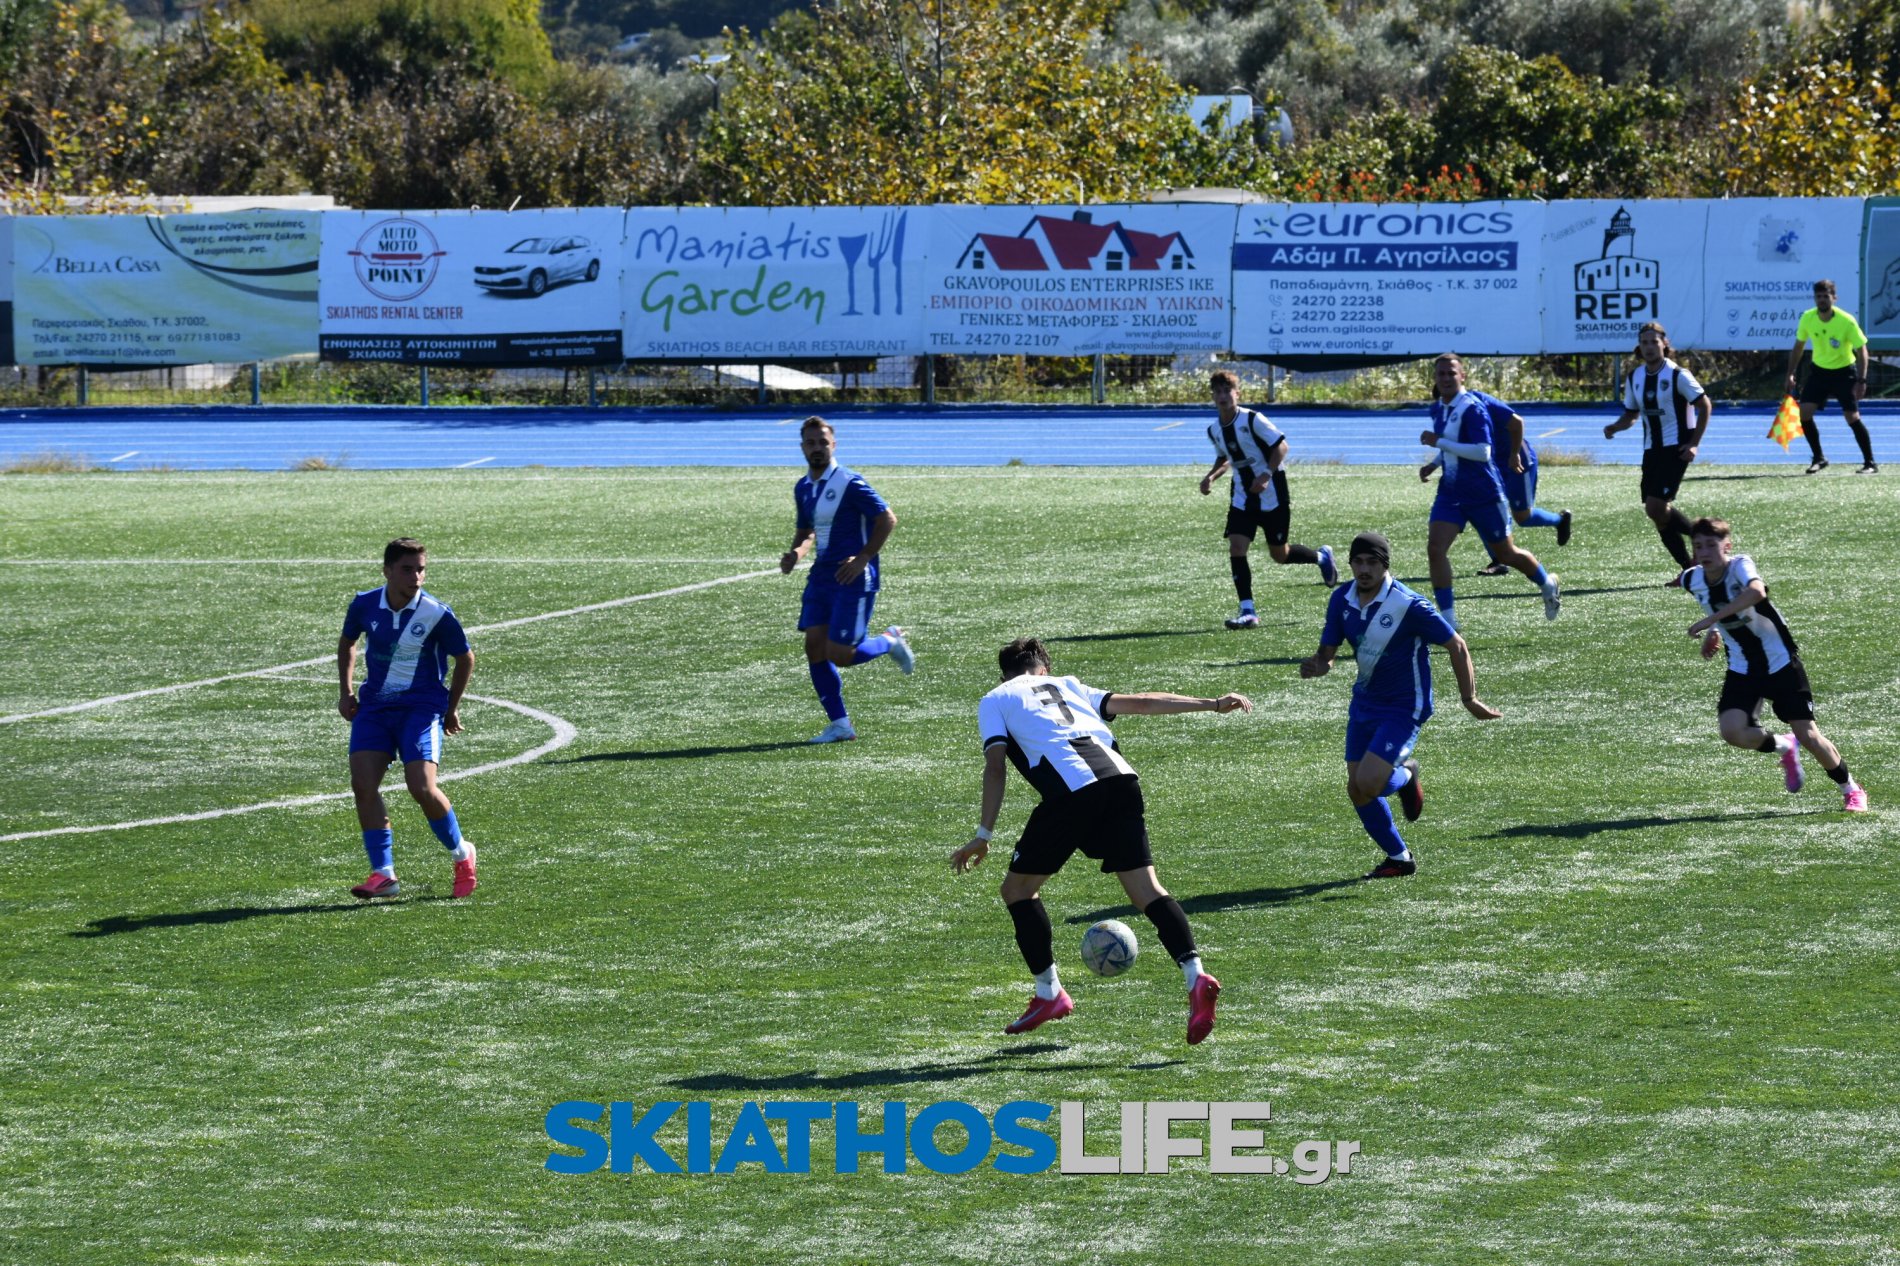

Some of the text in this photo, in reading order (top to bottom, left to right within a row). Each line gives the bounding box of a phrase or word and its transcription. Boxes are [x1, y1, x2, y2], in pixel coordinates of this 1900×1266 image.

[1283, 211, 1514, 238] euronics
[381, 227, 417, 240] AUTO
[378, 239, 418, 252] MOTO
[635, 221, 832, 269] Maniatis
[115, 256, 162, 273] CASA
[1270, 246, 1510, 269] Αδάμ Π. Αγησίλαος
[368, 268, 426, 284] POINT
[943, 275, 1067, 293] GKAVOPOULOS
[1070, 276, 1185, 292] ENTERPRISES
[1376, 278, 1433, 293] Σκιάθος
[1473, 278, 1490, 290] 37
[1492, 278, 1519, 291] 002
[1724, 281, 1815, 293] SKIATHOS SERV
[641, 264, 826, 333] Garden
[930, 294, 1224, 312] ΕΜΠΟΡΙΟ ΟΙΚΟΔΟΜΙΚΩΝ ΥΛΙΚΩΝ
[1291, 295, 1385, 307] 24270 22238
[327, 306, 464, 320] SKIATHOS RENTAL CENTER
[1575, 292, 1659, 320] REPI
[959, 313, 1024, 326] ΓΕΝΙΚΕΣ
[1027, 314, 1120, 328] ΜΕΤΑΦΟΡΕΣ
[1131, 313, 1198, 327] ΣΚΙΑΘΟΣ
[1291, 310, 1336, 322] 24270
[1340, 310, 1385, 322] 22238
[1125, 329, 1223, 340] www.gkavopoulos.gr
[1291, 324, 1468, 336] adam.agisilaos@euronics.gr
[1575, 322, 1628, 333] SKIATHOS
[75, 333, 108, 343] 24270
[965, 333, 1011, 346] 24270
[1014, 333, 1060, 347] 22107
[1291, 338, 1394, 351] www.euronics.gr
[648, 338, 908, 353] SKIATHOS BEACH BAR RESTAURANT
[1105, 340, 1223, 352] gkavopoulos@gmail.com
[348, 350, 403, 359] ΣΚΙΑΘΟΣ
[418, 350, 462, 359] ΒΟΛΟΣ
